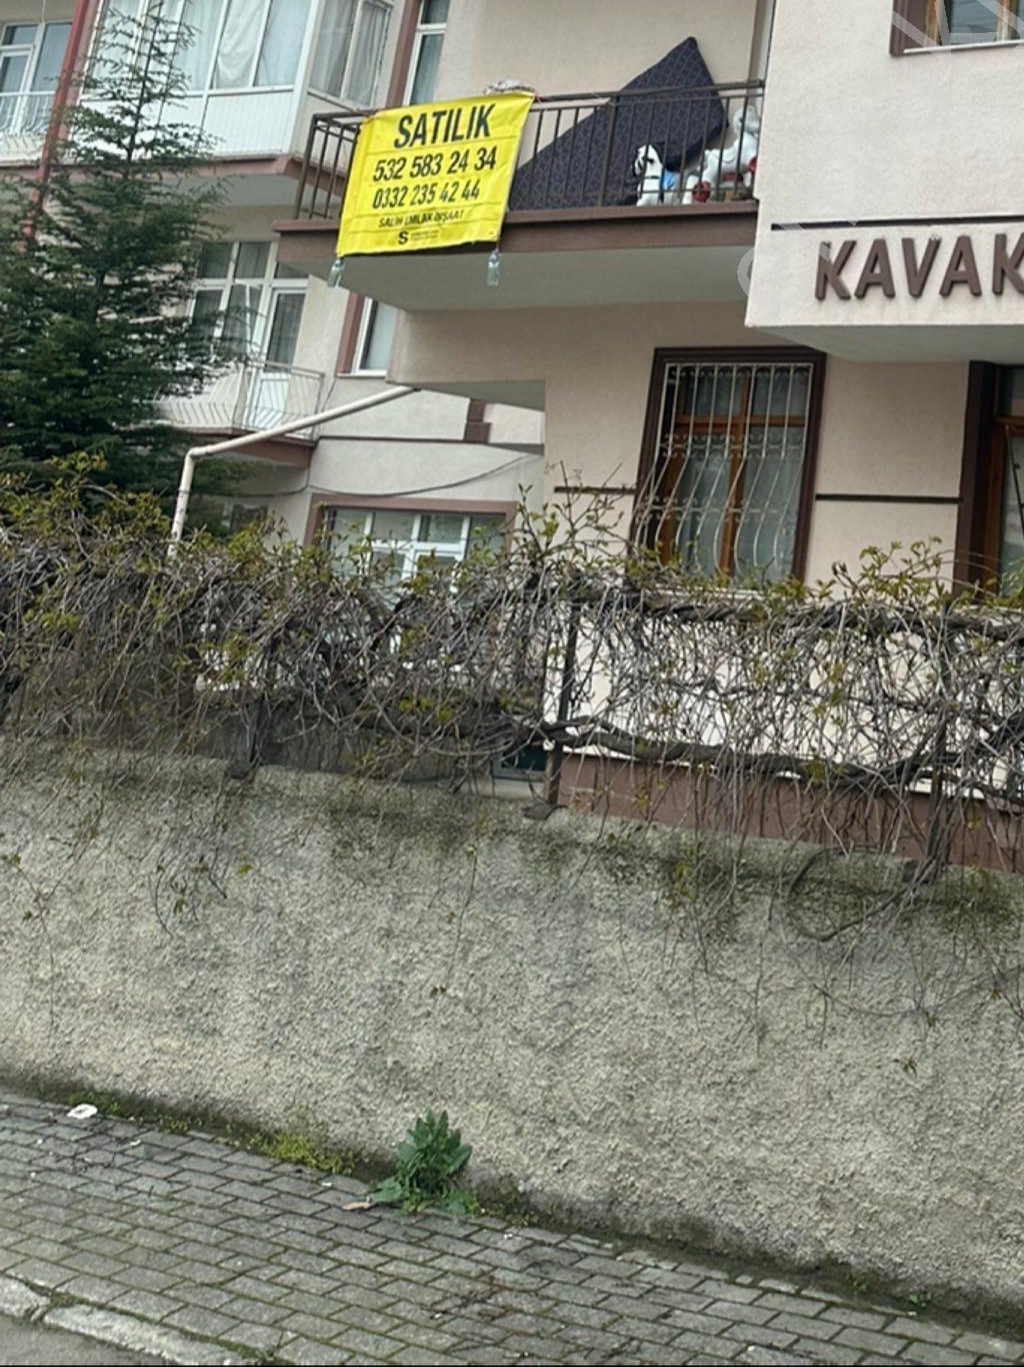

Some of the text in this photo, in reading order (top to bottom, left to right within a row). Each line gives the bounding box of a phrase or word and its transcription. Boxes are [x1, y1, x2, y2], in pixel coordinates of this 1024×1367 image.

[394, 103, 495, 149] SATILIK
[373, 146, 498, 182] 532 583 24 34
[372, 179, 481, 209] 0332 235 42 44
